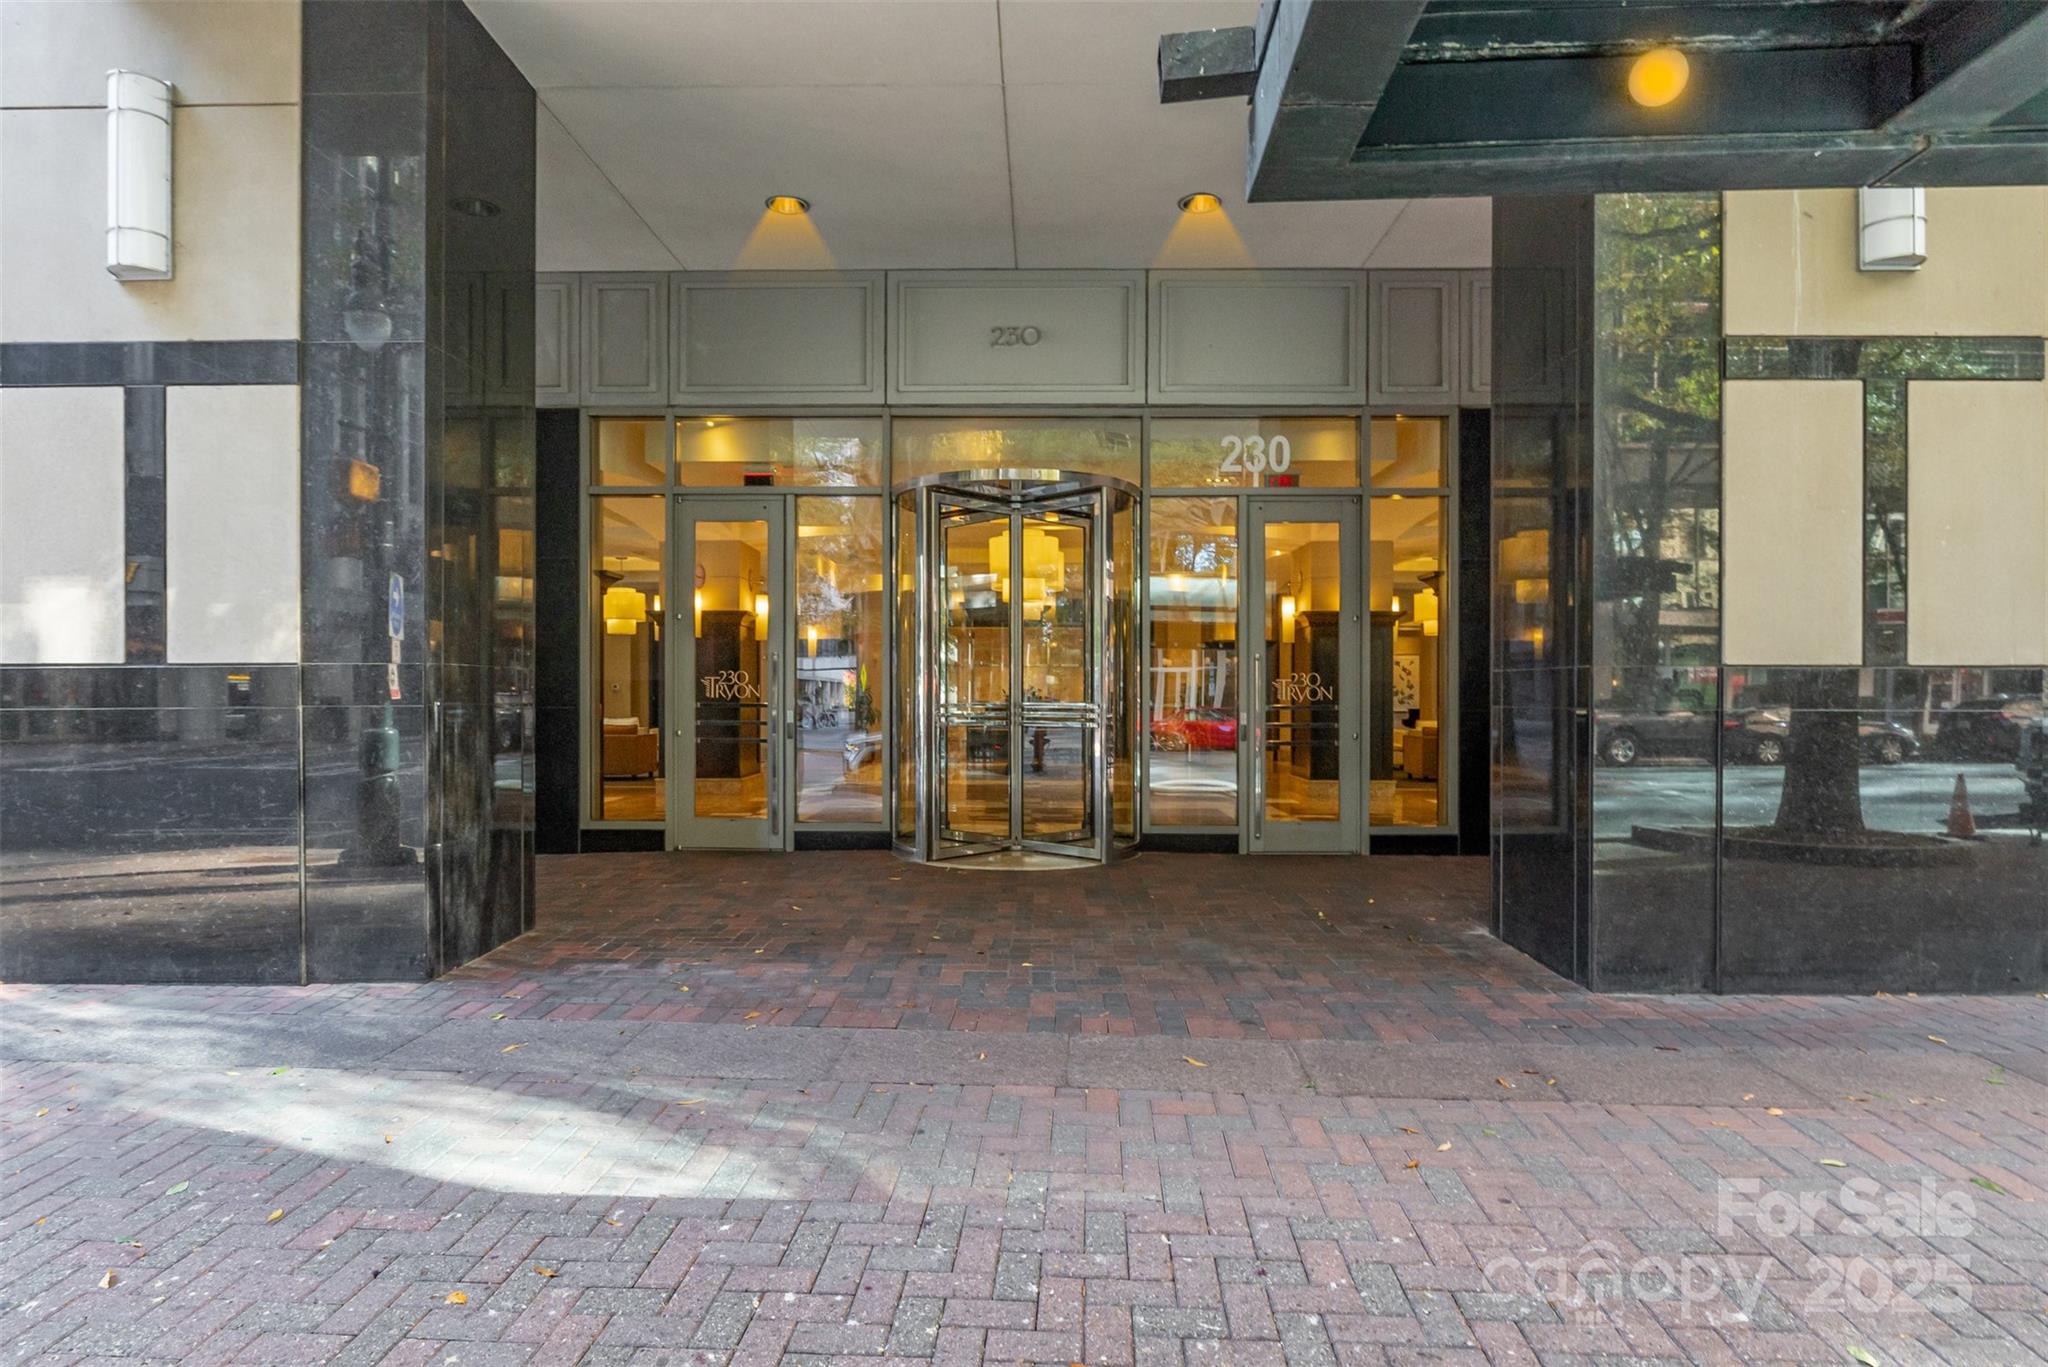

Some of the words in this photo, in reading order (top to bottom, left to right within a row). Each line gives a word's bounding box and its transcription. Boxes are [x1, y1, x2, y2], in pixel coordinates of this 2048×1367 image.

[991, 326, 1042, 348] 230
[1220, 435, 1291, 473] 230
[704, 676, 760, 701] TRYON
[719, 670, 749, 685] 230
[1291, 672, 1321, 687] 230
[1275, 678, 1333, 703] TRYON
